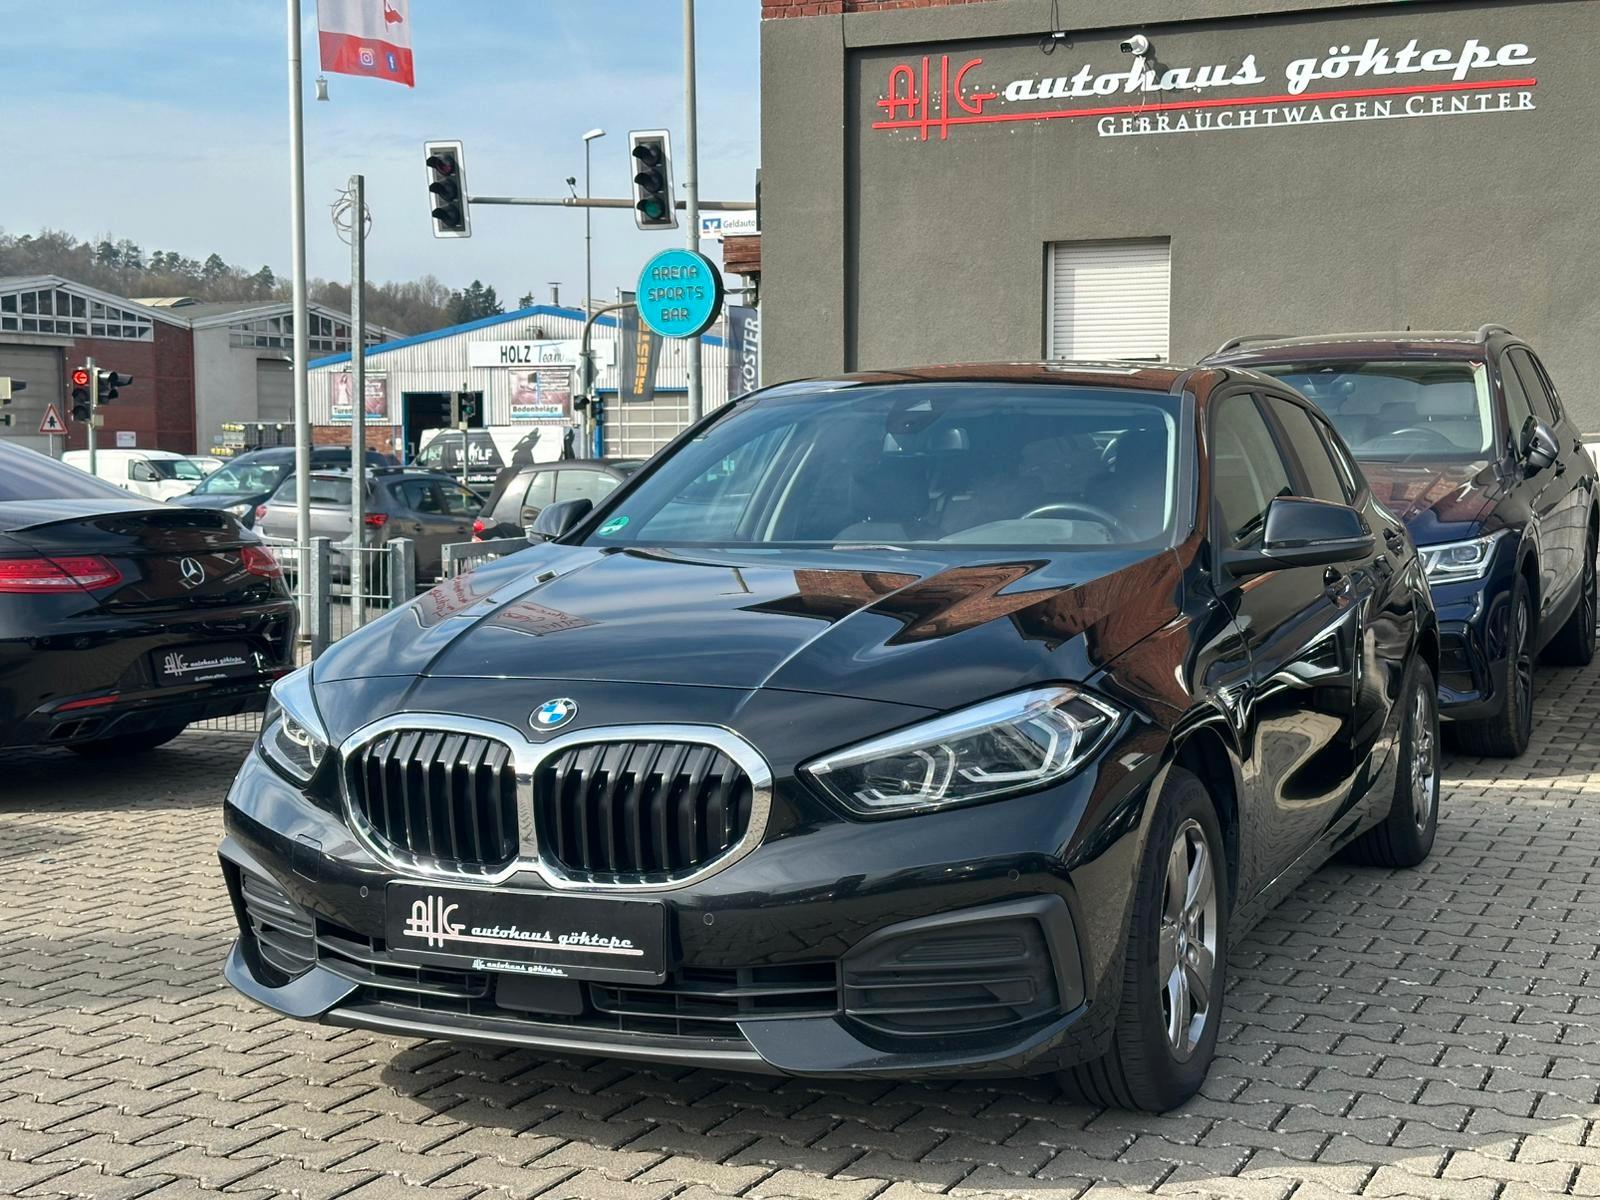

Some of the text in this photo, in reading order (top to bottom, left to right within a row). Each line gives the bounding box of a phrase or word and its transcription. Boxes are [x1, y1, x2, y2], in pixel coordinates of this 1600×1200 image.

[877, 38, 1537, 141] AHG autohaus göktepe
[1097, 91, 1537, 135] GEBRAUCHTWAGEN CENTER
[652, 265, 698, 280] ARENA
[648, 285, 704, 301] SPORTS
[660, 307, 689, 322] BAR
[500, 341, 565, 364] HOLZ Team
[405, 895, 634, 950] AHG autohaus göktepe
